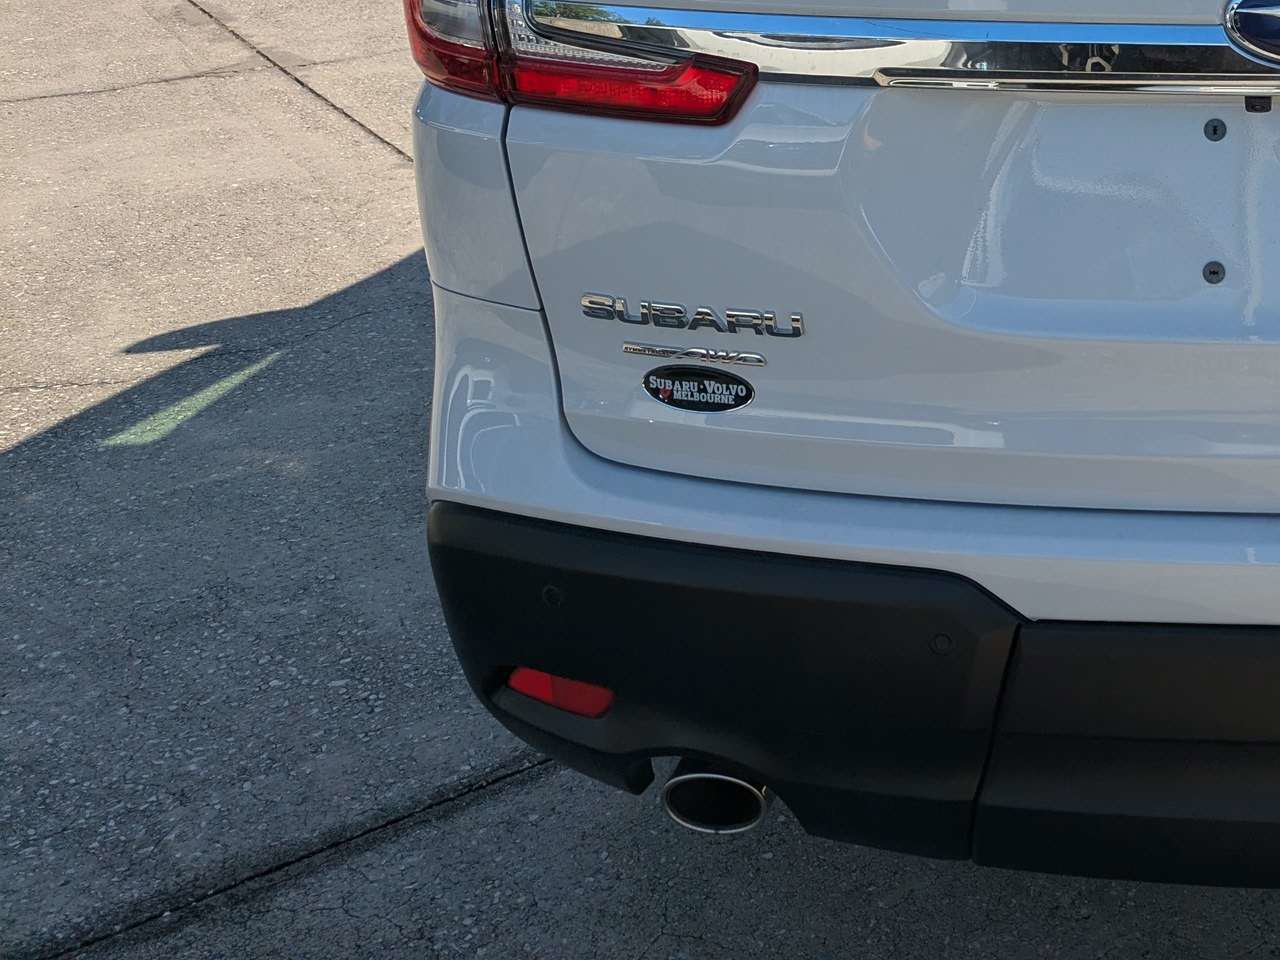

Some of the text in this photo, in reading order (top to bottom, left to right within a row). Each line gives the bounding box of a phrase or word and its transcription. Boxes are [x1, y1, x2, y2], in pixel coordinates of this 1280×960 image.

[580, 292, 805, 338] SUBARU
[649, 375, 747, 397] SUBARU VOLVO
[673, 390, 735, 404] MELBOURNE
